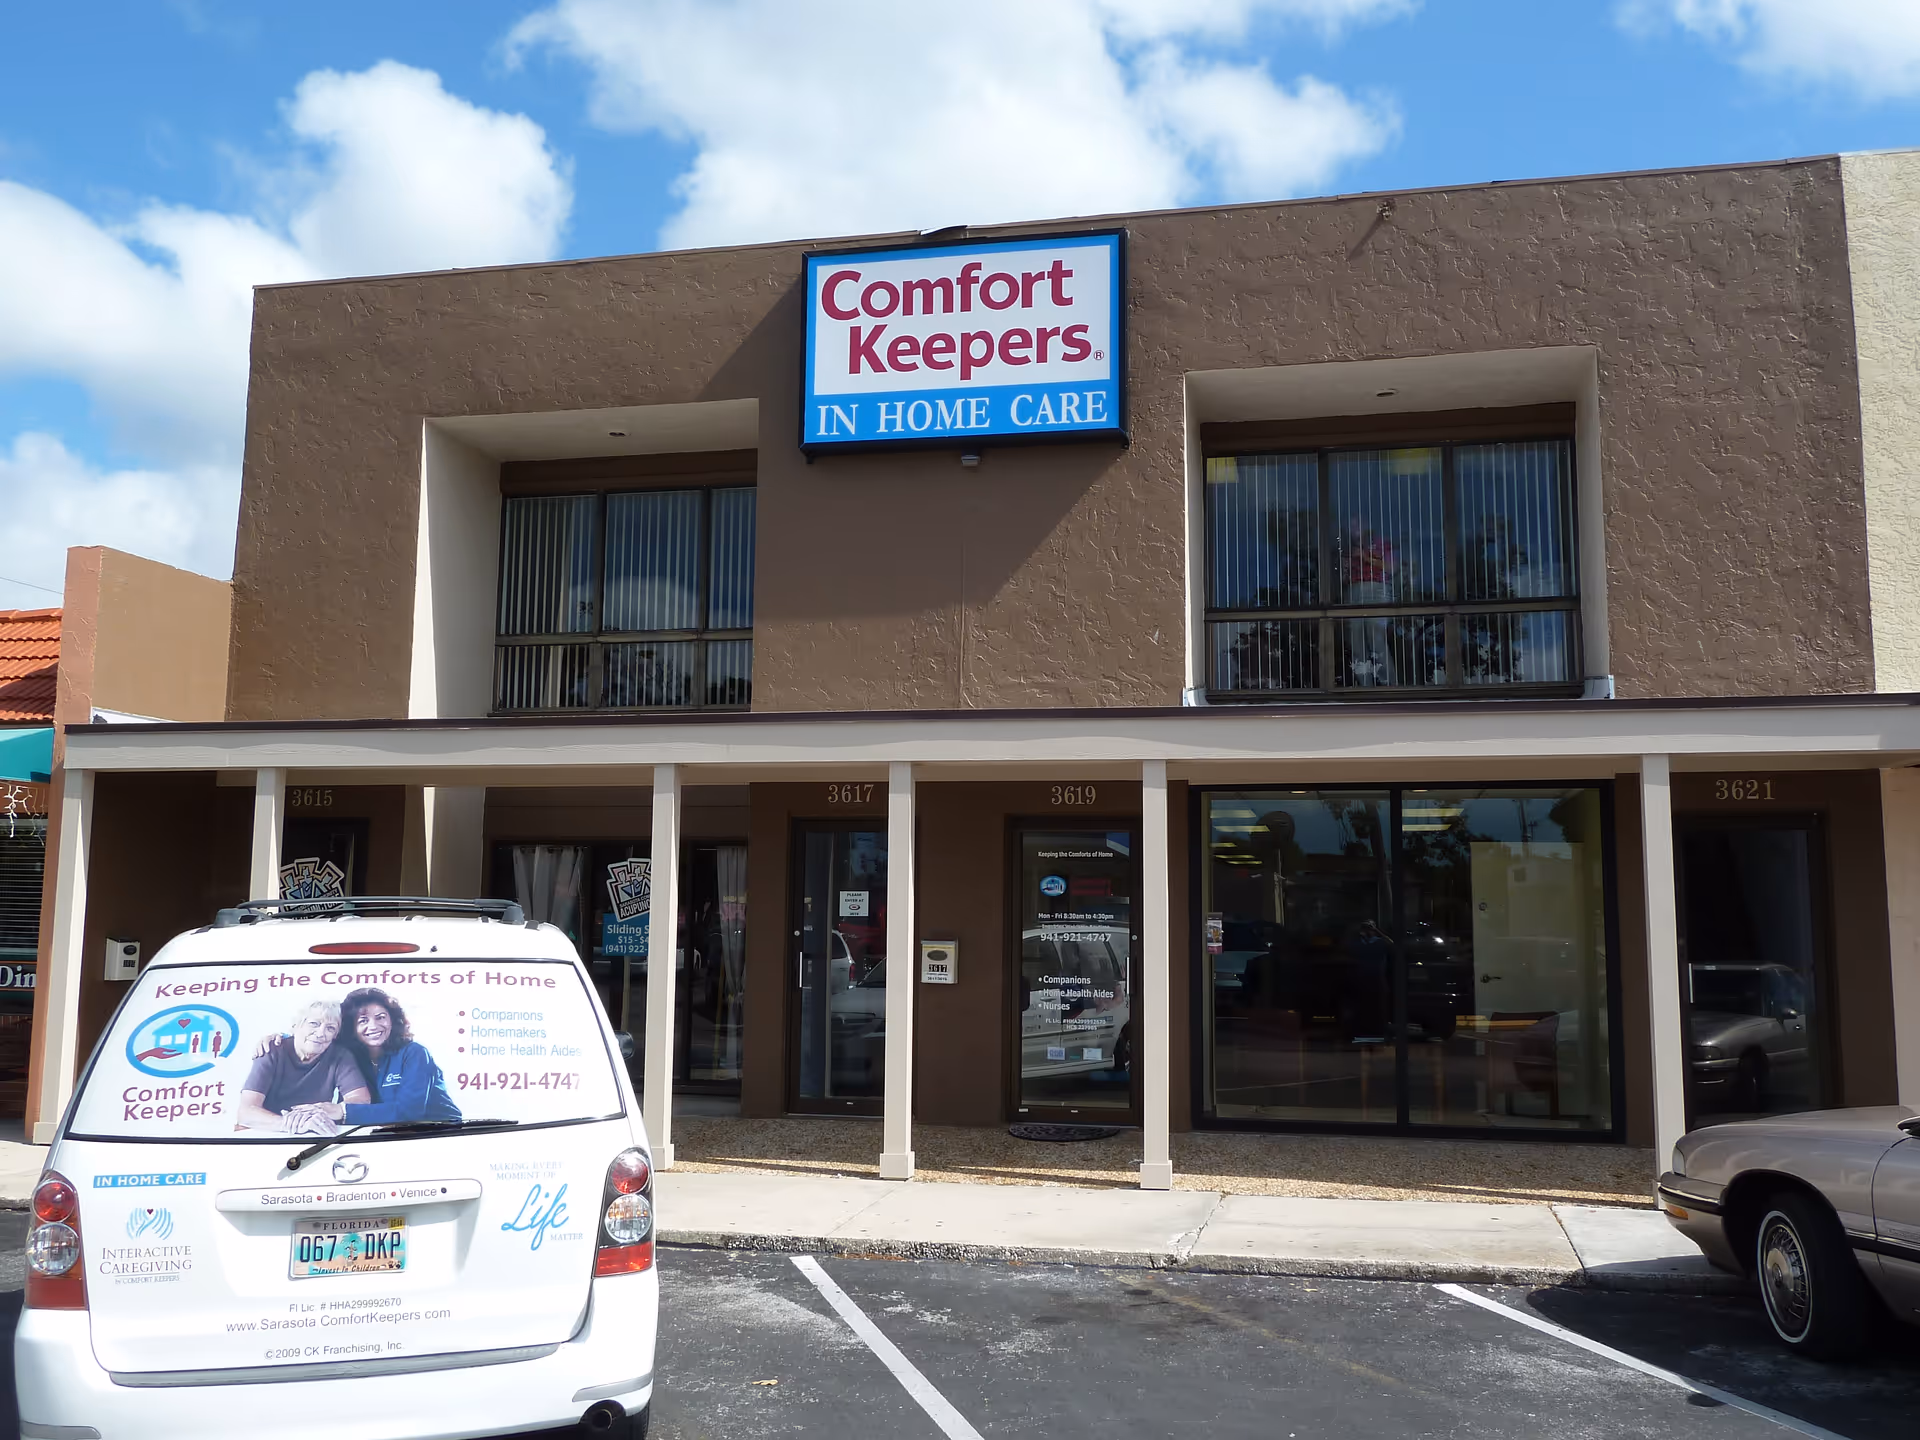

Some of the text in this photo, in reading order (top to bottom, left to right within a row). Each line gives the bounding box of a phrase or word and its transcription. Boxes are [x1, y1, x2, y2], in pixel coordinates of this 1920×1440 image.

[821, 260, 1073, 320] Comfort
[816, 390, 1107, 436] IN HOME CARE
[827, 784, 874, 803] 3617
[1051, 785, 1096, 805] 3619
[1715, 779, 1776, 800] 3621
[292, 789, 333, 806] 3615
[607, 924, 642, 936] Sliding
[1040, 932, 1112, 942] 941-921-4747
[618, 936, 633, 944] $15
[605, 945, 627, 954] (941)
[155, 970, 556, 998] Keeping the Comforts of Home
[1043, 975, 1091, 985] Companions
[1043, 989, 1114, 998] Home Health Aides
[1043, 1002, 1070, 1010] Nurses
[471, 1007, 544, 1022] Companions
[471, 1025, 547, 1038] Homemakers
[471, 1043, 582, 1057] Home Health Aides
[457, 1072, 580, 1090] 941-921-4747
[122, 1080, 225, 1103] Comfort
[123, 1101, 222, 1122] Keepers
[489, 1163, 529, 1171] MAKING
[96, 1174, 203, 1187] IN HOME CARE
[496, 1171, 556, 1180] MOMENT OF
[261, 1187, 437, 1205] Sarasota Bradenton Venice
[501, 1183, 569, 1251] Life
[323, 1220, 380, 1231] FLORIDA
[550, 1233, 583, 1241] MATTER
[102, 1245, 192, 1260] INTERACTIVE
[300, 1231, 401, 1263] 067 DKP
[100, 1259, 192, 1275] CAREGIVING
[318, 1266, 339, 1274] Invest
[351, 1264, 381, 1272] Children
[122, 1276, 153, 1284] COMFORT
[154, 1275, 180, 1283] KEEPERS
[320, 1302, 327, 1311] #
[330, 1298, 402, 1311] HHA299992670
[320, 1311, 421, 1327] ComfortKeepers
[424, 1309, 451, 1319] com
[304, 1347, 320, 1357] CK
[323, 1343, 383, 1356] Franchising,
[387, 1341, 405, 1350] Inc.
